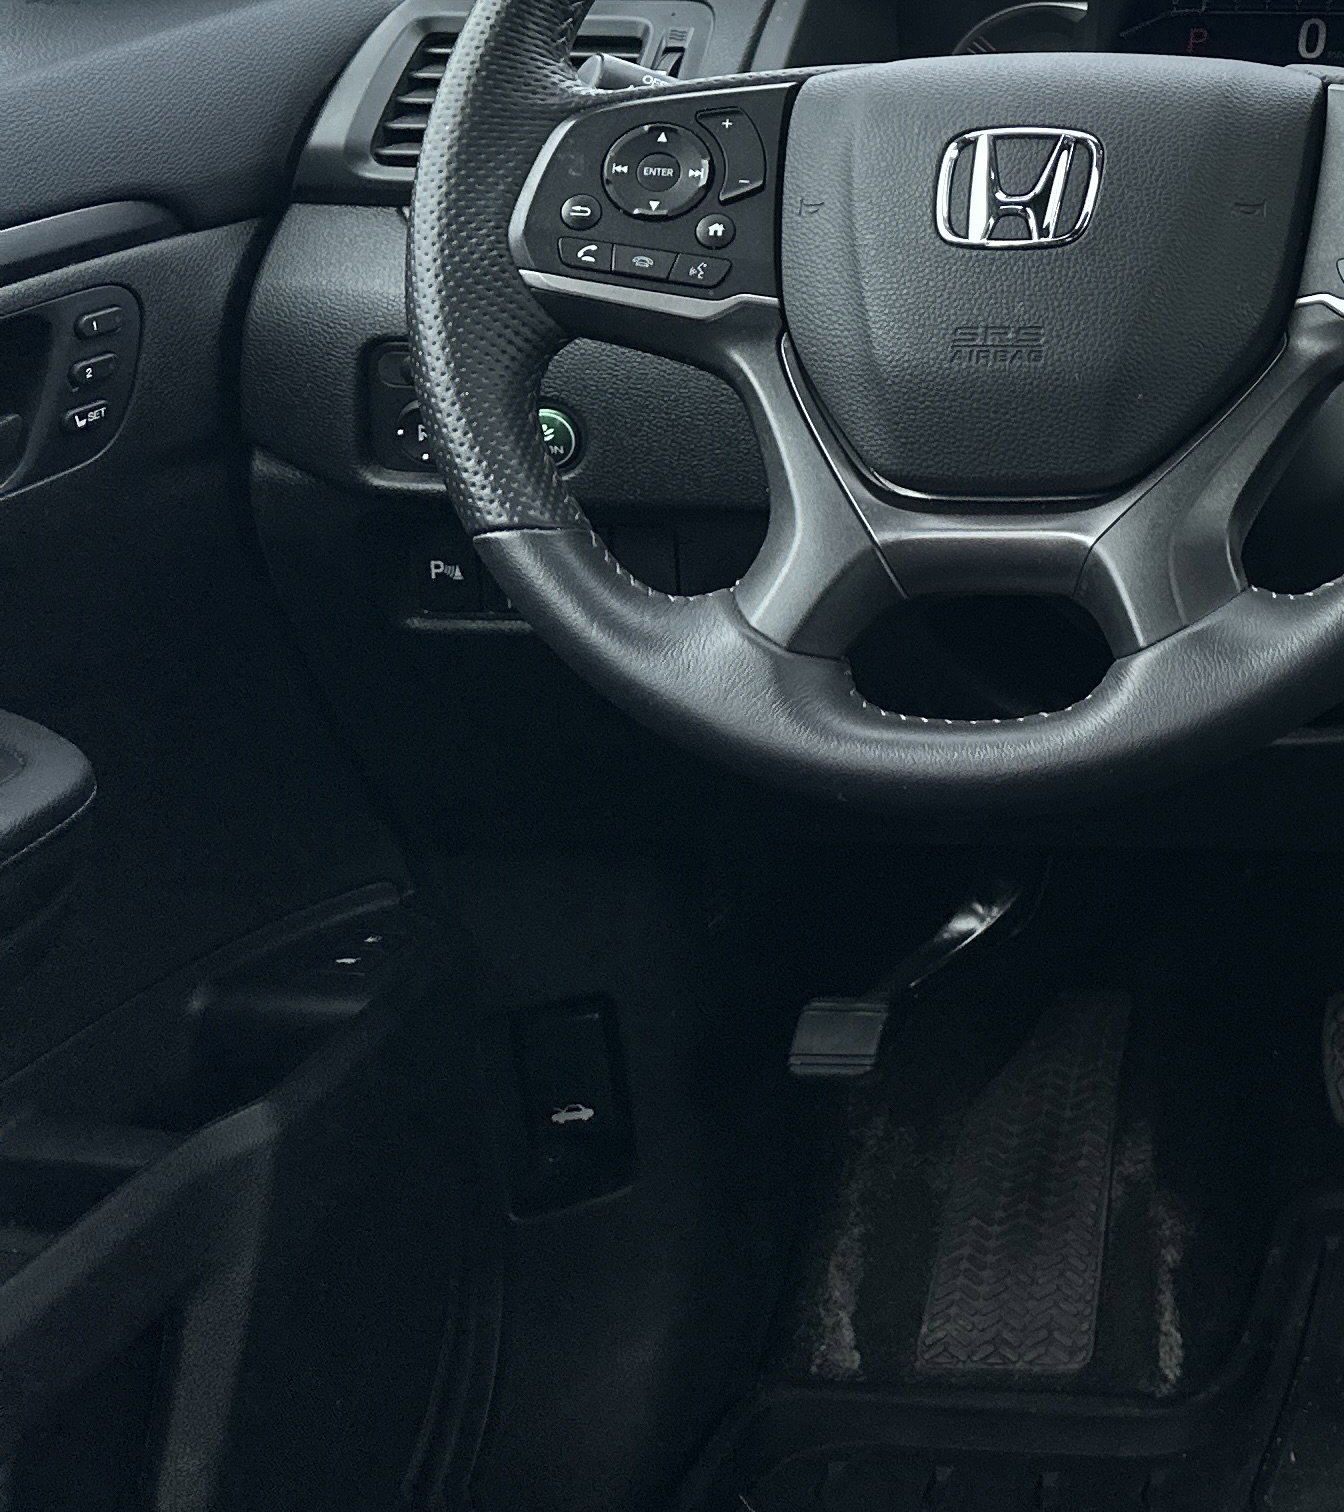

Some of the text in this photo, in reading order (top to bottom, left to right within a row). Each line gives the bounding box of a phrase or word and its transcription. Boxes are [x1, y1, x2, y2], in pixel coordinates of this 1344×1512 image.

[1298, 18, 1327, 59] 0
[643, 166, 674, 178] ENTER
[92, 320, 99, 331] 1
[950, 325, 1045, 346] SRS
[950, 349, 1045, 364] AIRBAG
[85, 367, 93, 379] 2
[87, 407, 107, 423] SET
